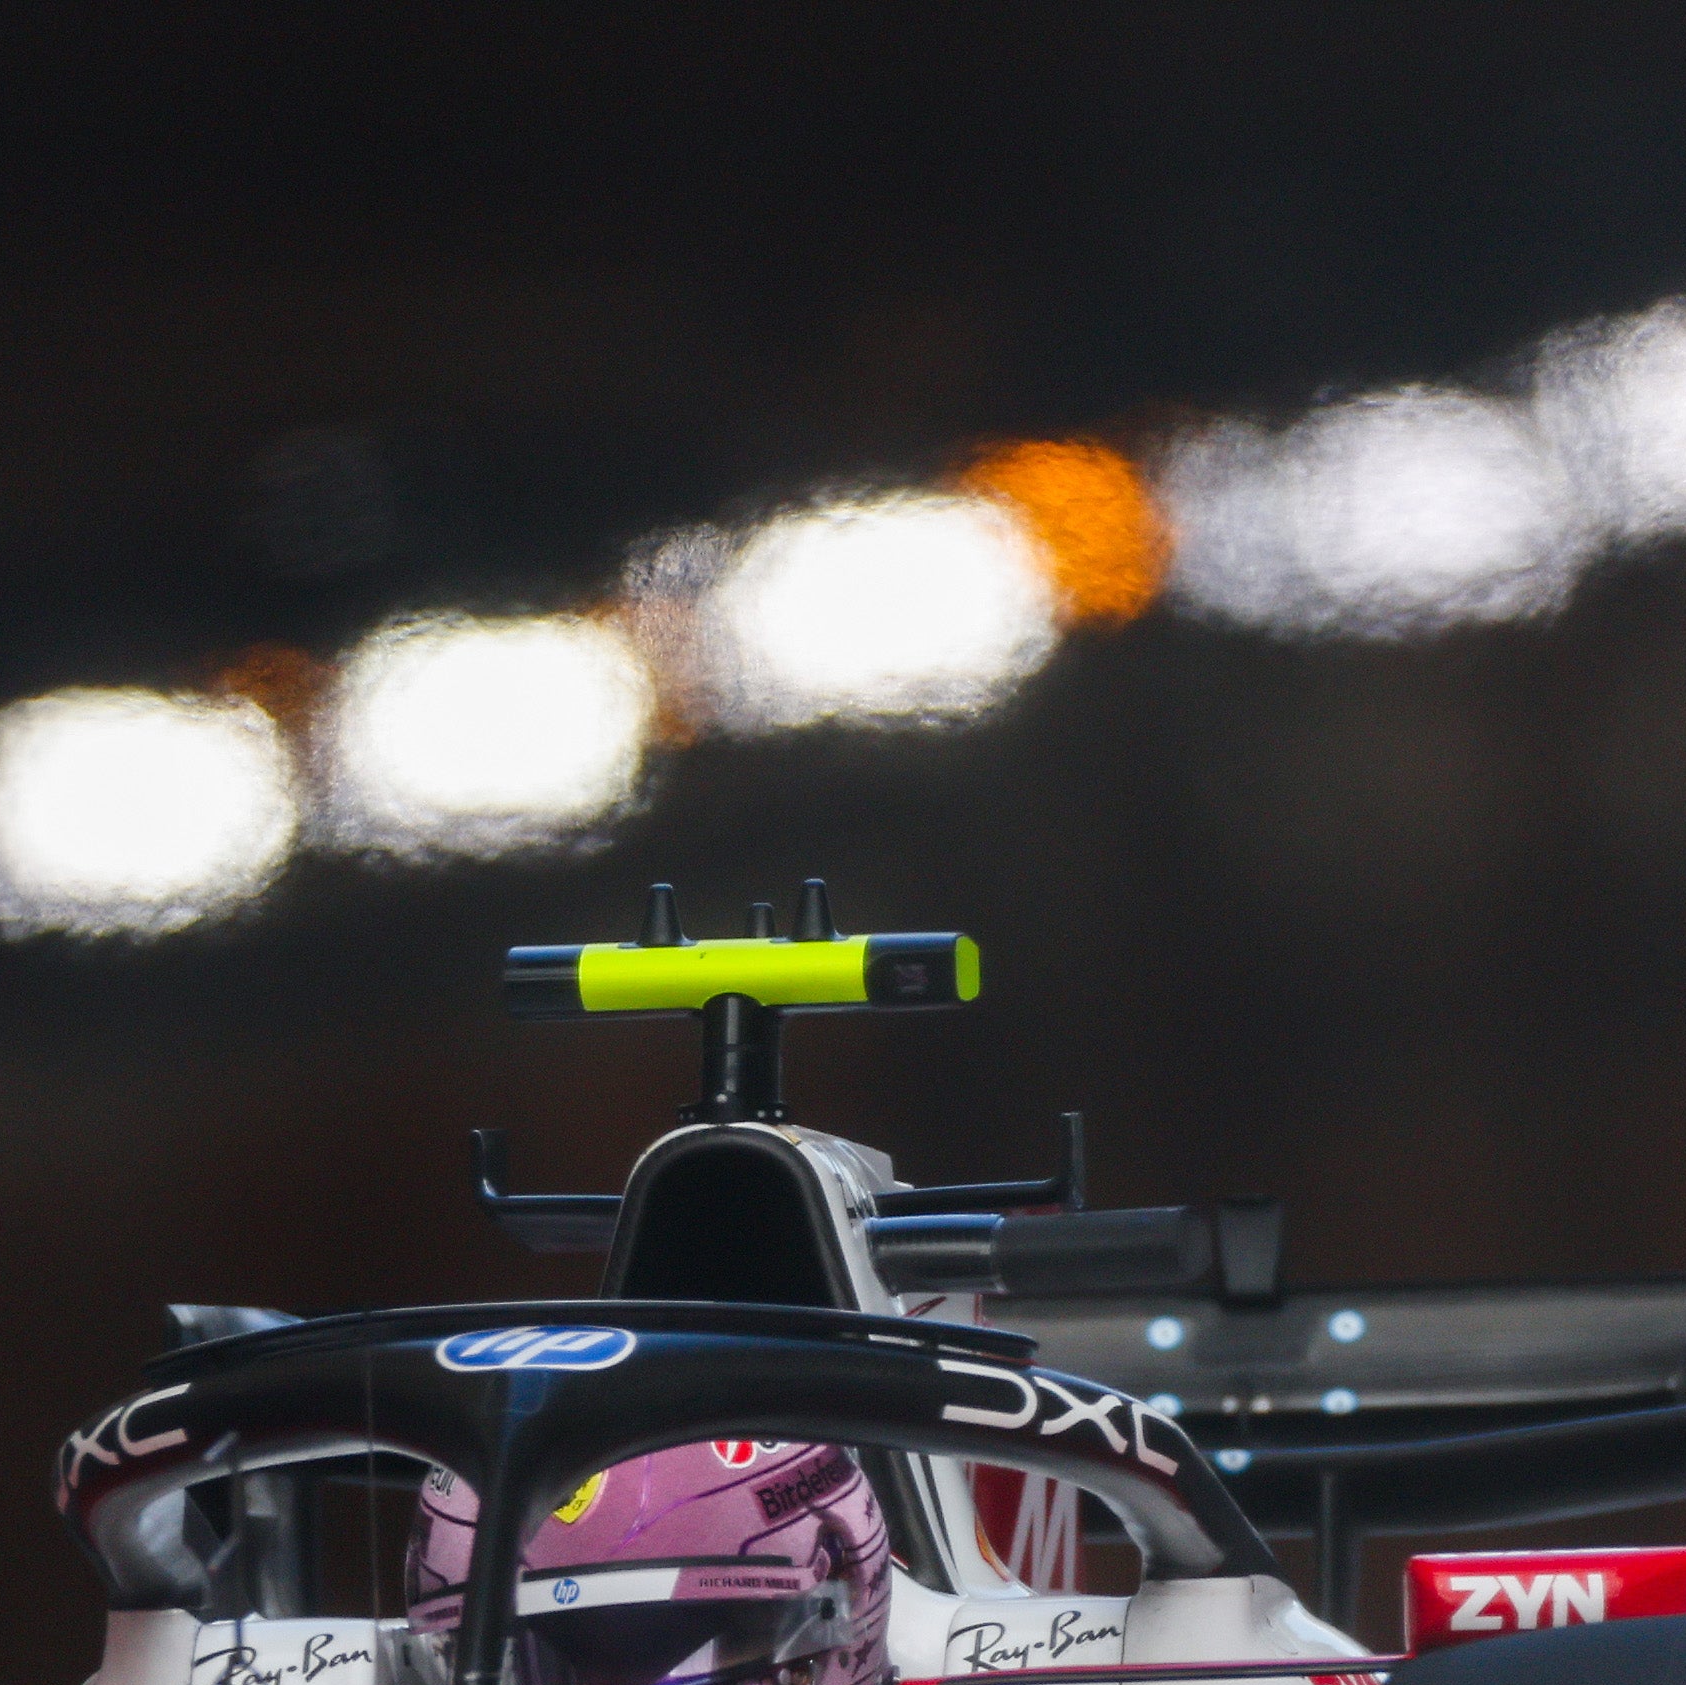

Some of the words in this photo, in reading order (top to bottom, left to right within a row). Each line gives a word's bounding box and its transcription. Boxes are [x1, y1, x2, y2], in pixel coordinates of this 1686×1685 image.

[459, 1326, 615, 1368] hp
[1449, 1572, 1605, 1630] ZYN
[946, 1610, 1123, 1669] Ray-Ban
